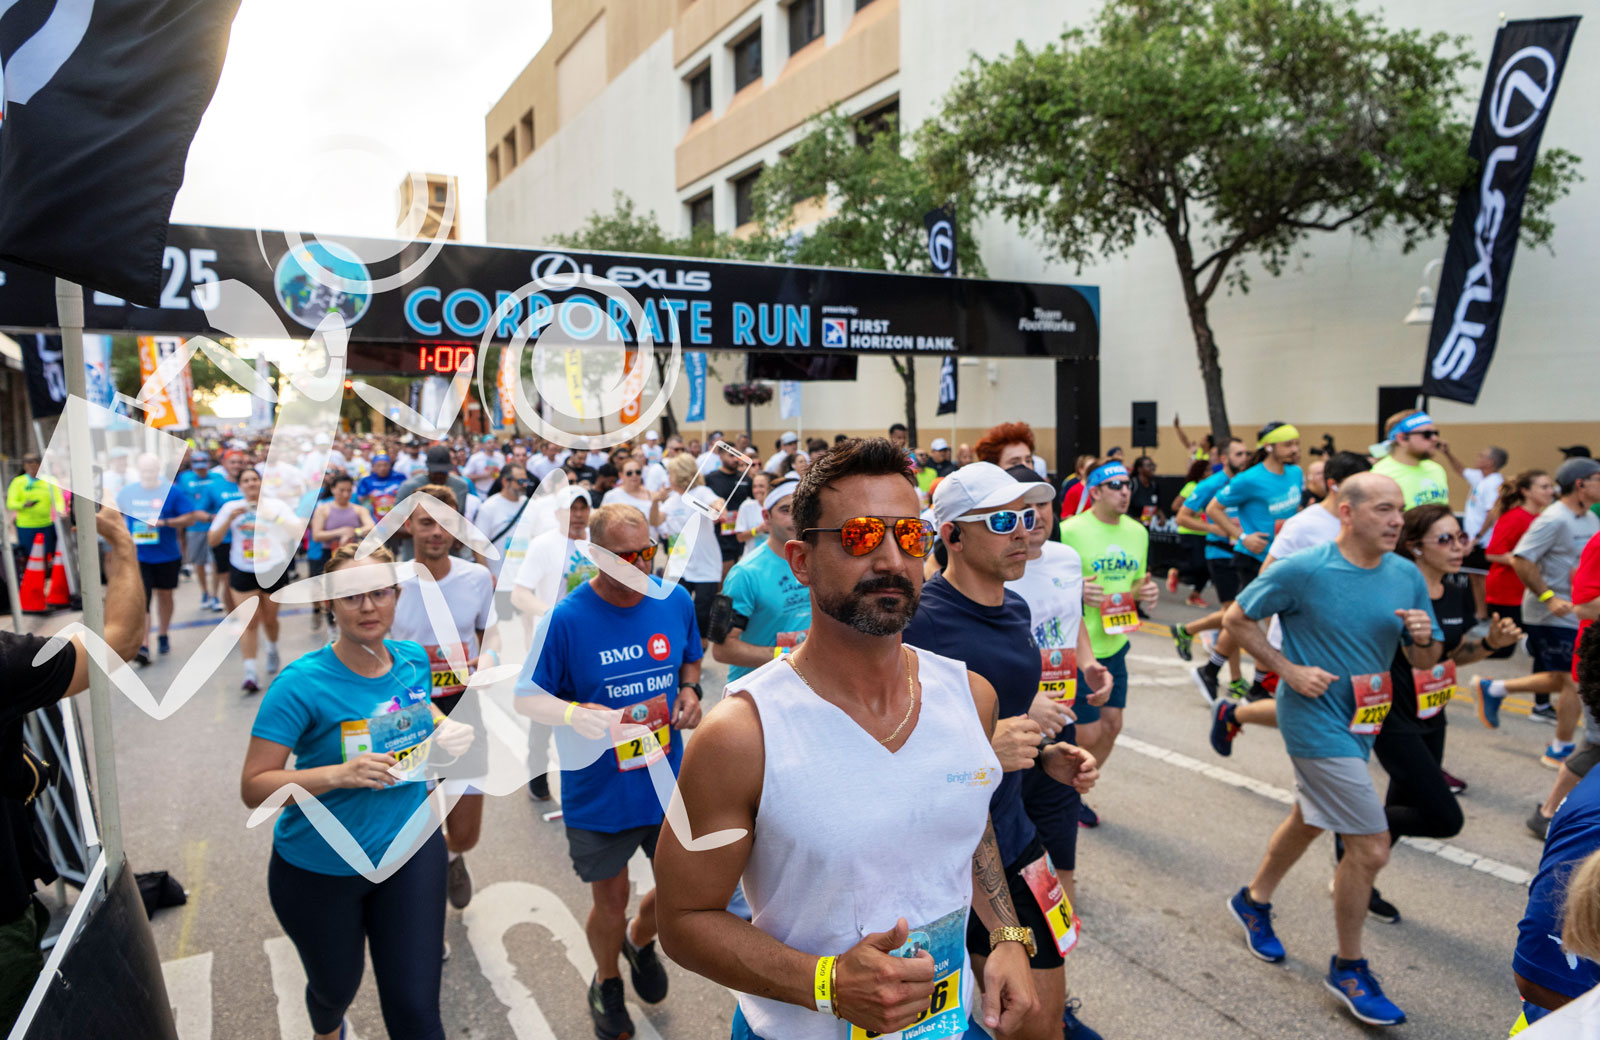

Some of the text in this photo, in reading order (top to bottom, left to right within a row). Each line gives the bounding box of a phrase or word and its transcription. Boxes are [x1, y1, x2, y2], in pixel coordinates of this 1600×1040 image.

[1431, 146, 1518, 380] LEXUS
[583, 263, 713, 292] LEXUS
[403, 286, 811, 347] CORPORATE RUN
[850, 319, 890, 334] FIRST
[850, 334, 914, 350] HORIZON
[598, 644, 643, 666] BMO
[605, 673, 673, 699] Team BMO
[630, 732, 662, 758] 284
[934, 958, 949, 972] RUN
[905, 1021, 936, 1040] Walker
